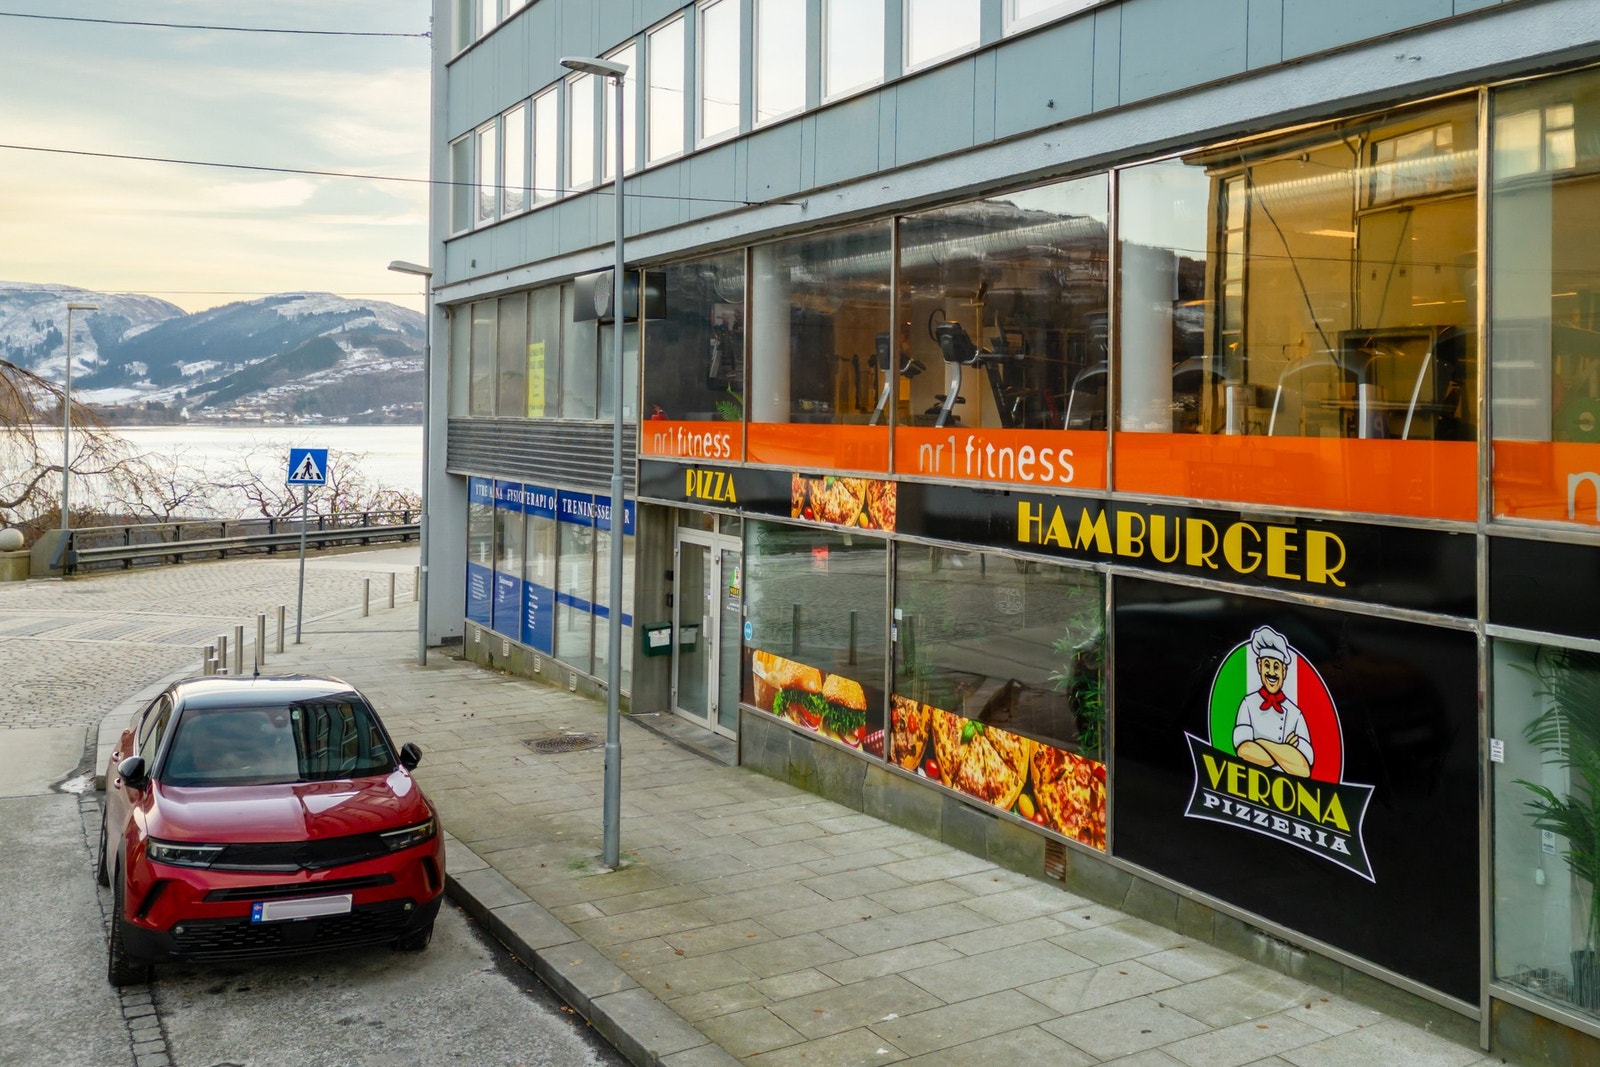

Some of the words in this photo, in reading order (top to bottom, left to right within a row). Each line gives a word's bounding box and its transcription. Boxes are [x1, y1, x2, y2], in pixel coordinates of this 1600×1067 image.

[654, 426, 673, 455] nr1
[677, 426, 731, 458] fitness
[919, 435, 956, 475] nr1
[965, 435, 1074, 483] fitness
[685, 468, 737, 503] PIZZA
[562, 498, 630, 524] TRENINGSSER
[1017, 501, 1347, 587] HAMBURGER
[1202, 754, 1351, 832] VERONA
[1203, 792, 1351, 856] PIZZERIA
